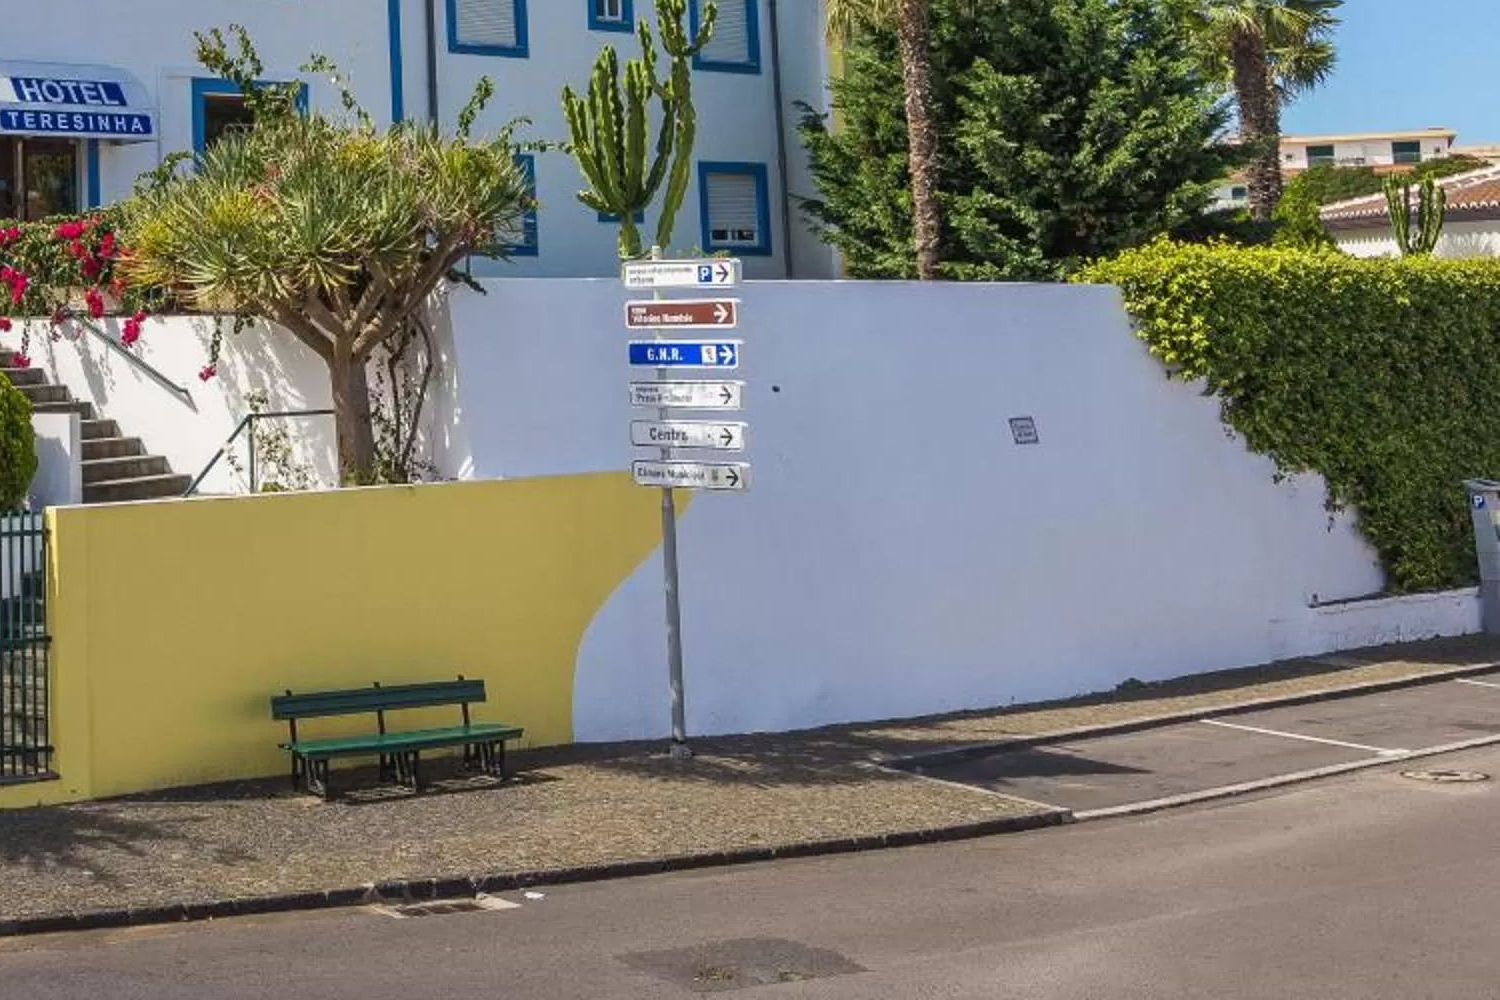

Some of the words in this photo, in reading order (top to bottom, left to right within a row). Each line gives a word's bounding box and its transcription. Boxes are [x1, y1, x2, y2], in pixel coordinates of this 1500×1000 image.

[18, 78, 120, 105] HOTEL
[6, 111, 145, 133] TERESINHA
[647, 348, 684, 361] G.N.R.
